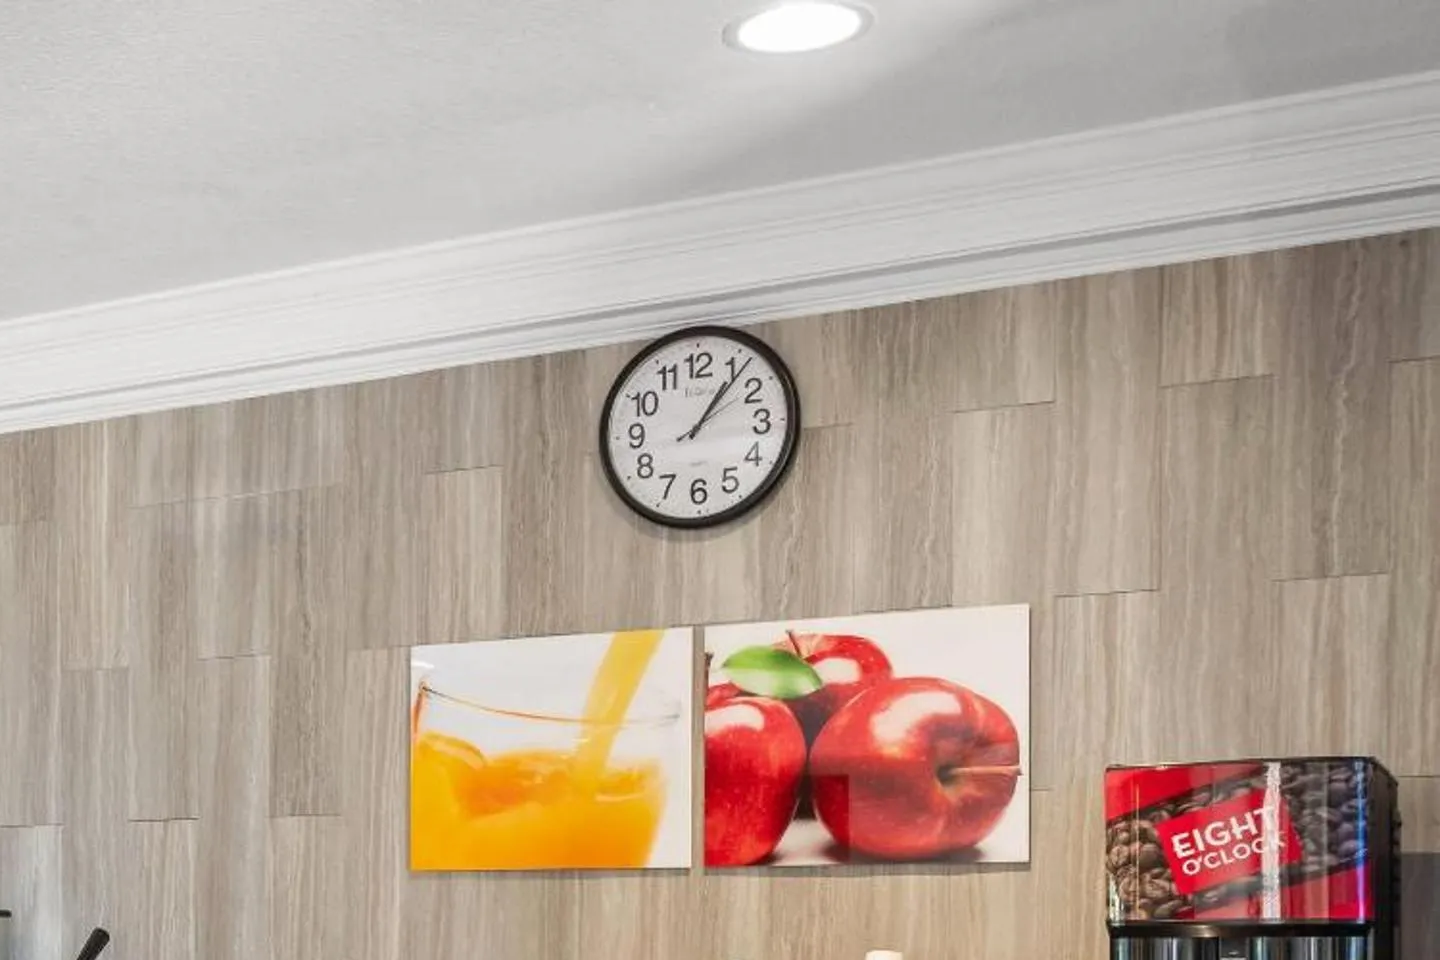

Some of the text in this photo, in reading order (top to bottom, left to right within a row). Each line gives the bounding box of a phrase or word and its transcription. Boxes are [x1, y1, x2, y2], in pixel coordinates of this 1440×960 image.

[657, 364, 678, 391] 11
[684, 352, 713, 379] 12
[725, 357, 736, 380] 1
[631, 391, 659, 417] 10
[744, 378, 762, 404] 2
[752, 408, 771, 435] 3
[628, 423, 645, 449] 9
[637, 453, 653, 479] 8
[744, 441, 762, 467] 4
[659, 474, 676, 500] 7
[690, 478, 708, 505] 6
[722, 466, 739, 494] 5
[1171, 805, 1275, 859] EIGHT
